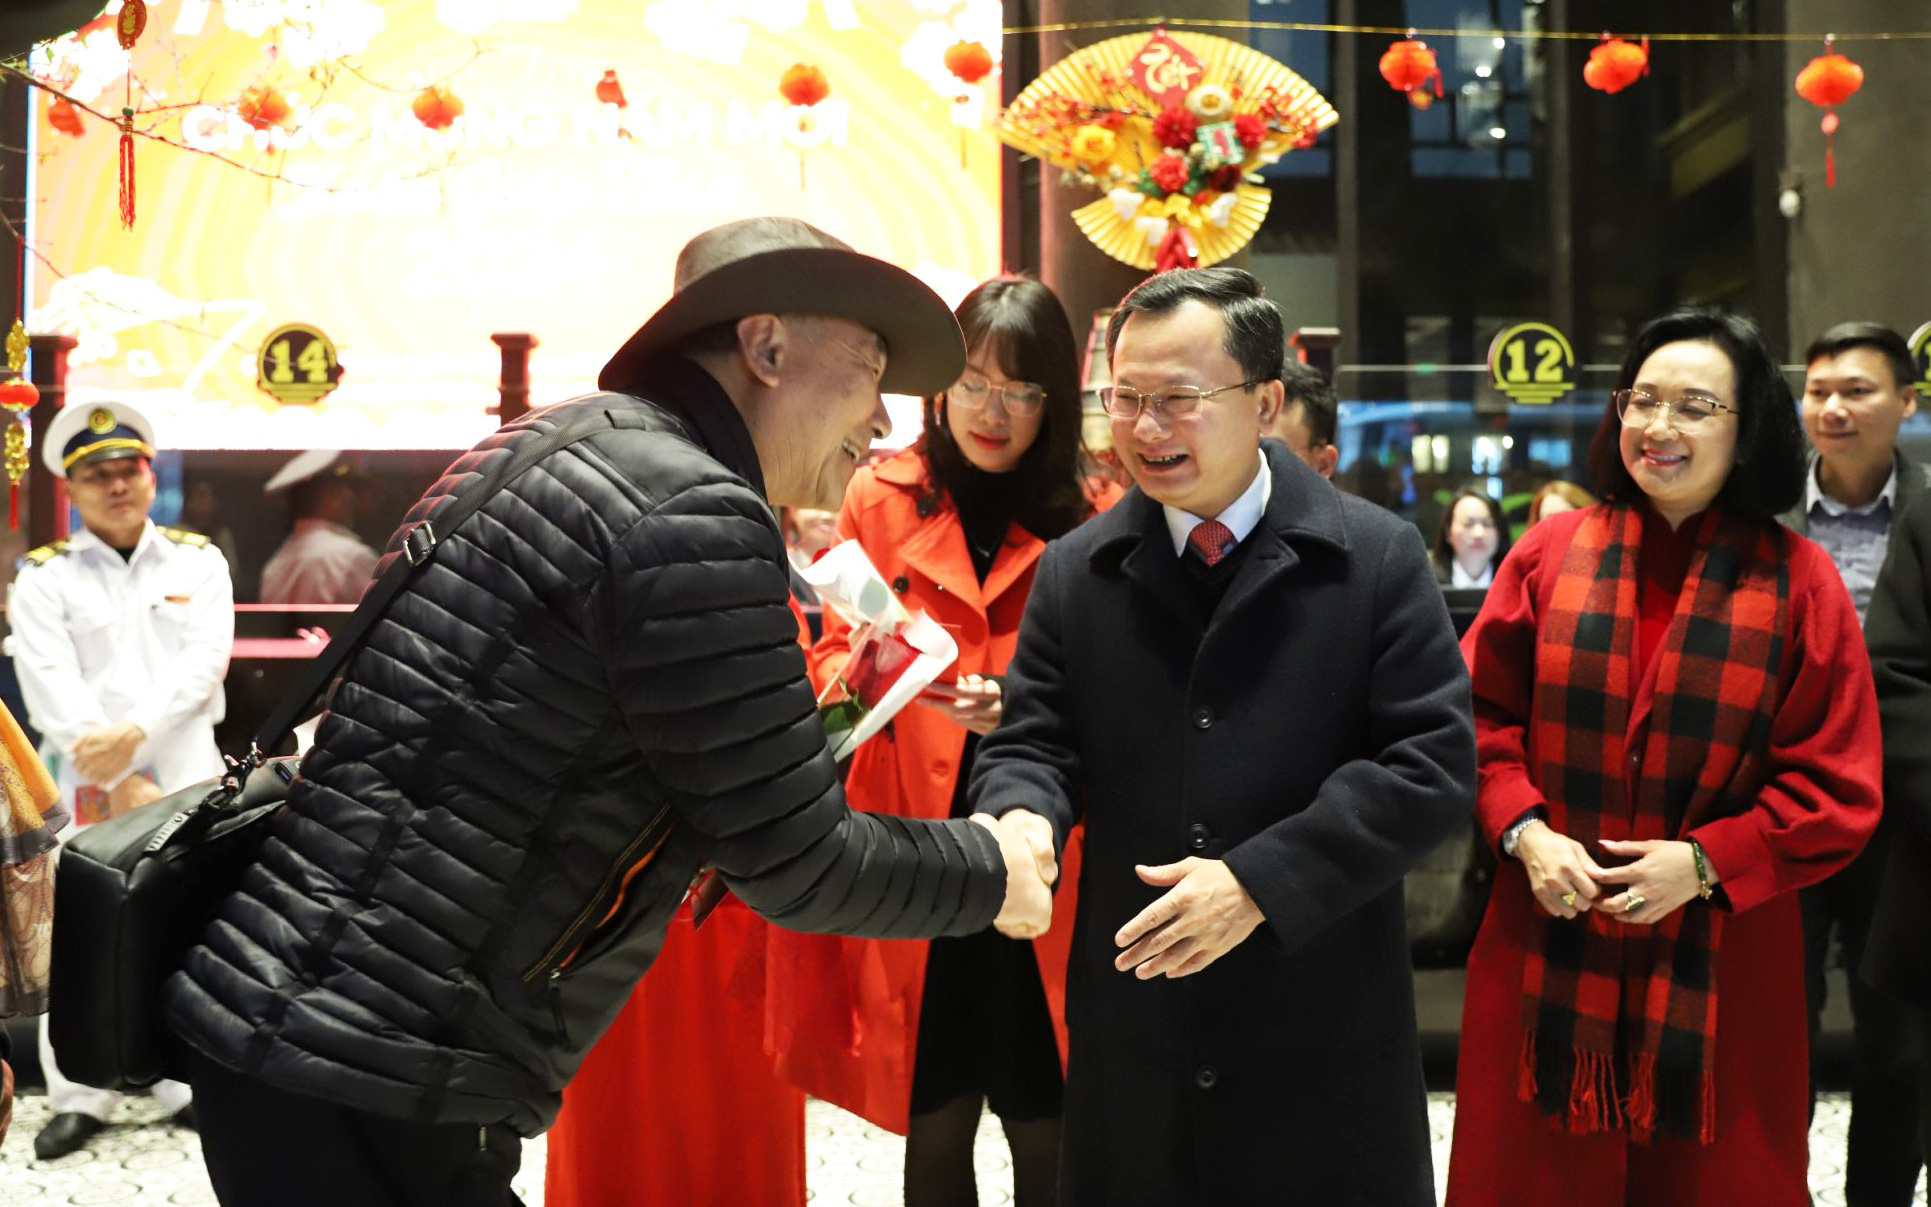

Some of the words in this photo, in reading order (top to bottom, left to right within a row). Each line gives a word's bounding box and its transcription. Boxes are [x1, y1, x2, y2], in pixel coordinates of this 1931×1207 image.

[400, 228, 604, 299] 2024
[271, 339, 328, 383] 14
[1506, 339, 1563, 383] 12
